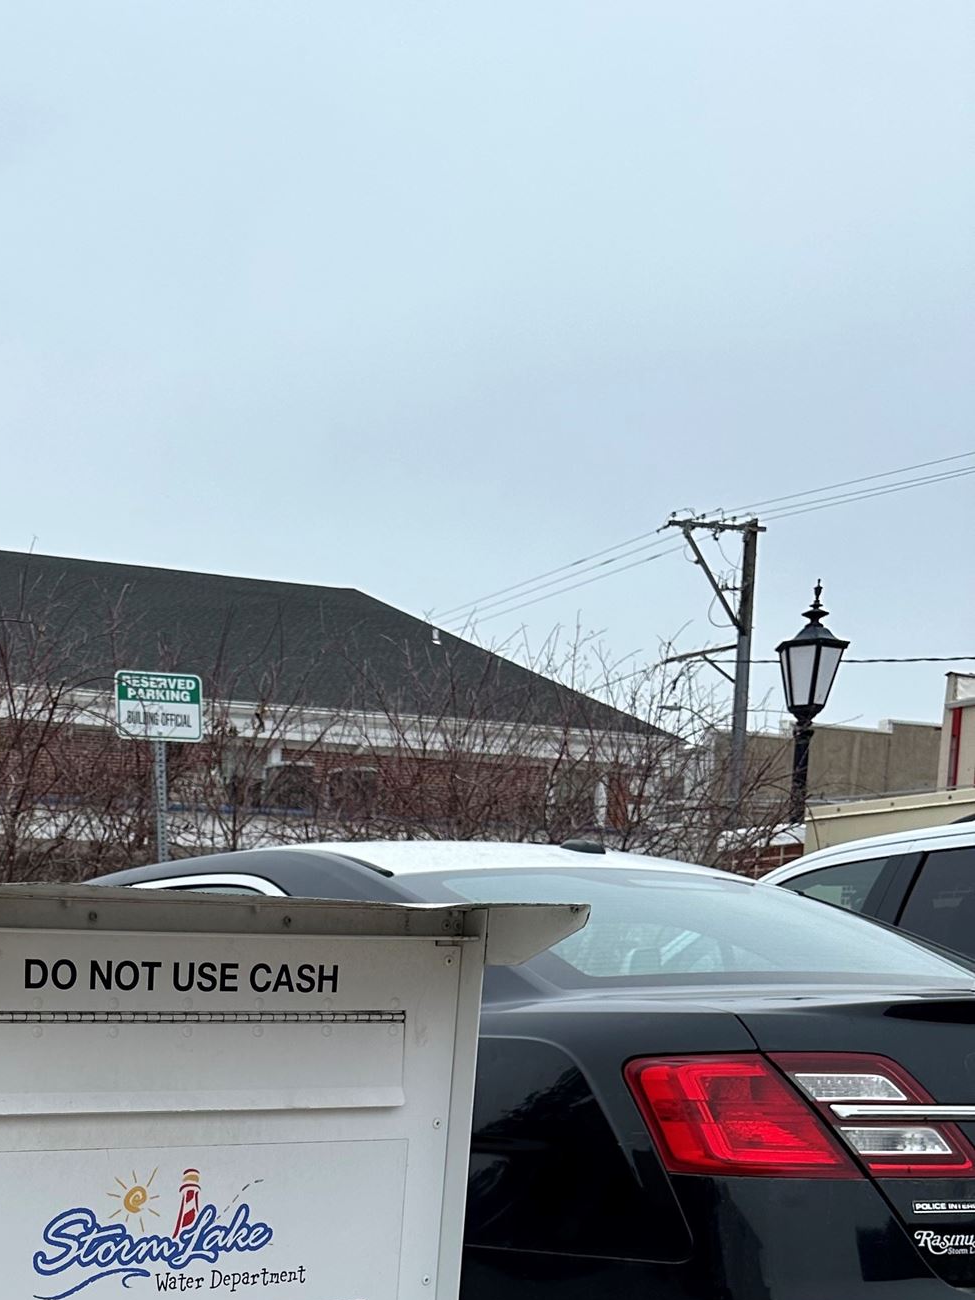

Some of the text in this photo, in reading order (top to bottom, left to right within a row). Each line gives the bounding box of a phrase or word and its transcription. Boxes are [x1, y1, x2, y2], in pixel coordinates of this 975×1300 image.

[122, 675, 196, 691] RESERVED
[127, 688, 191, 702] PARKING
[126, 710, 192, 728] BUILDING OFFICIAL
[24, 958, 339, 993] DO NOT USE CASH
[33, 1203, 273, 1276] Storm Lake
[914, 1230, 975, 1255] Rasmu
[948, 1247, 968, 1255] Storm
[155, 1265, 306, 1293] Water Department
